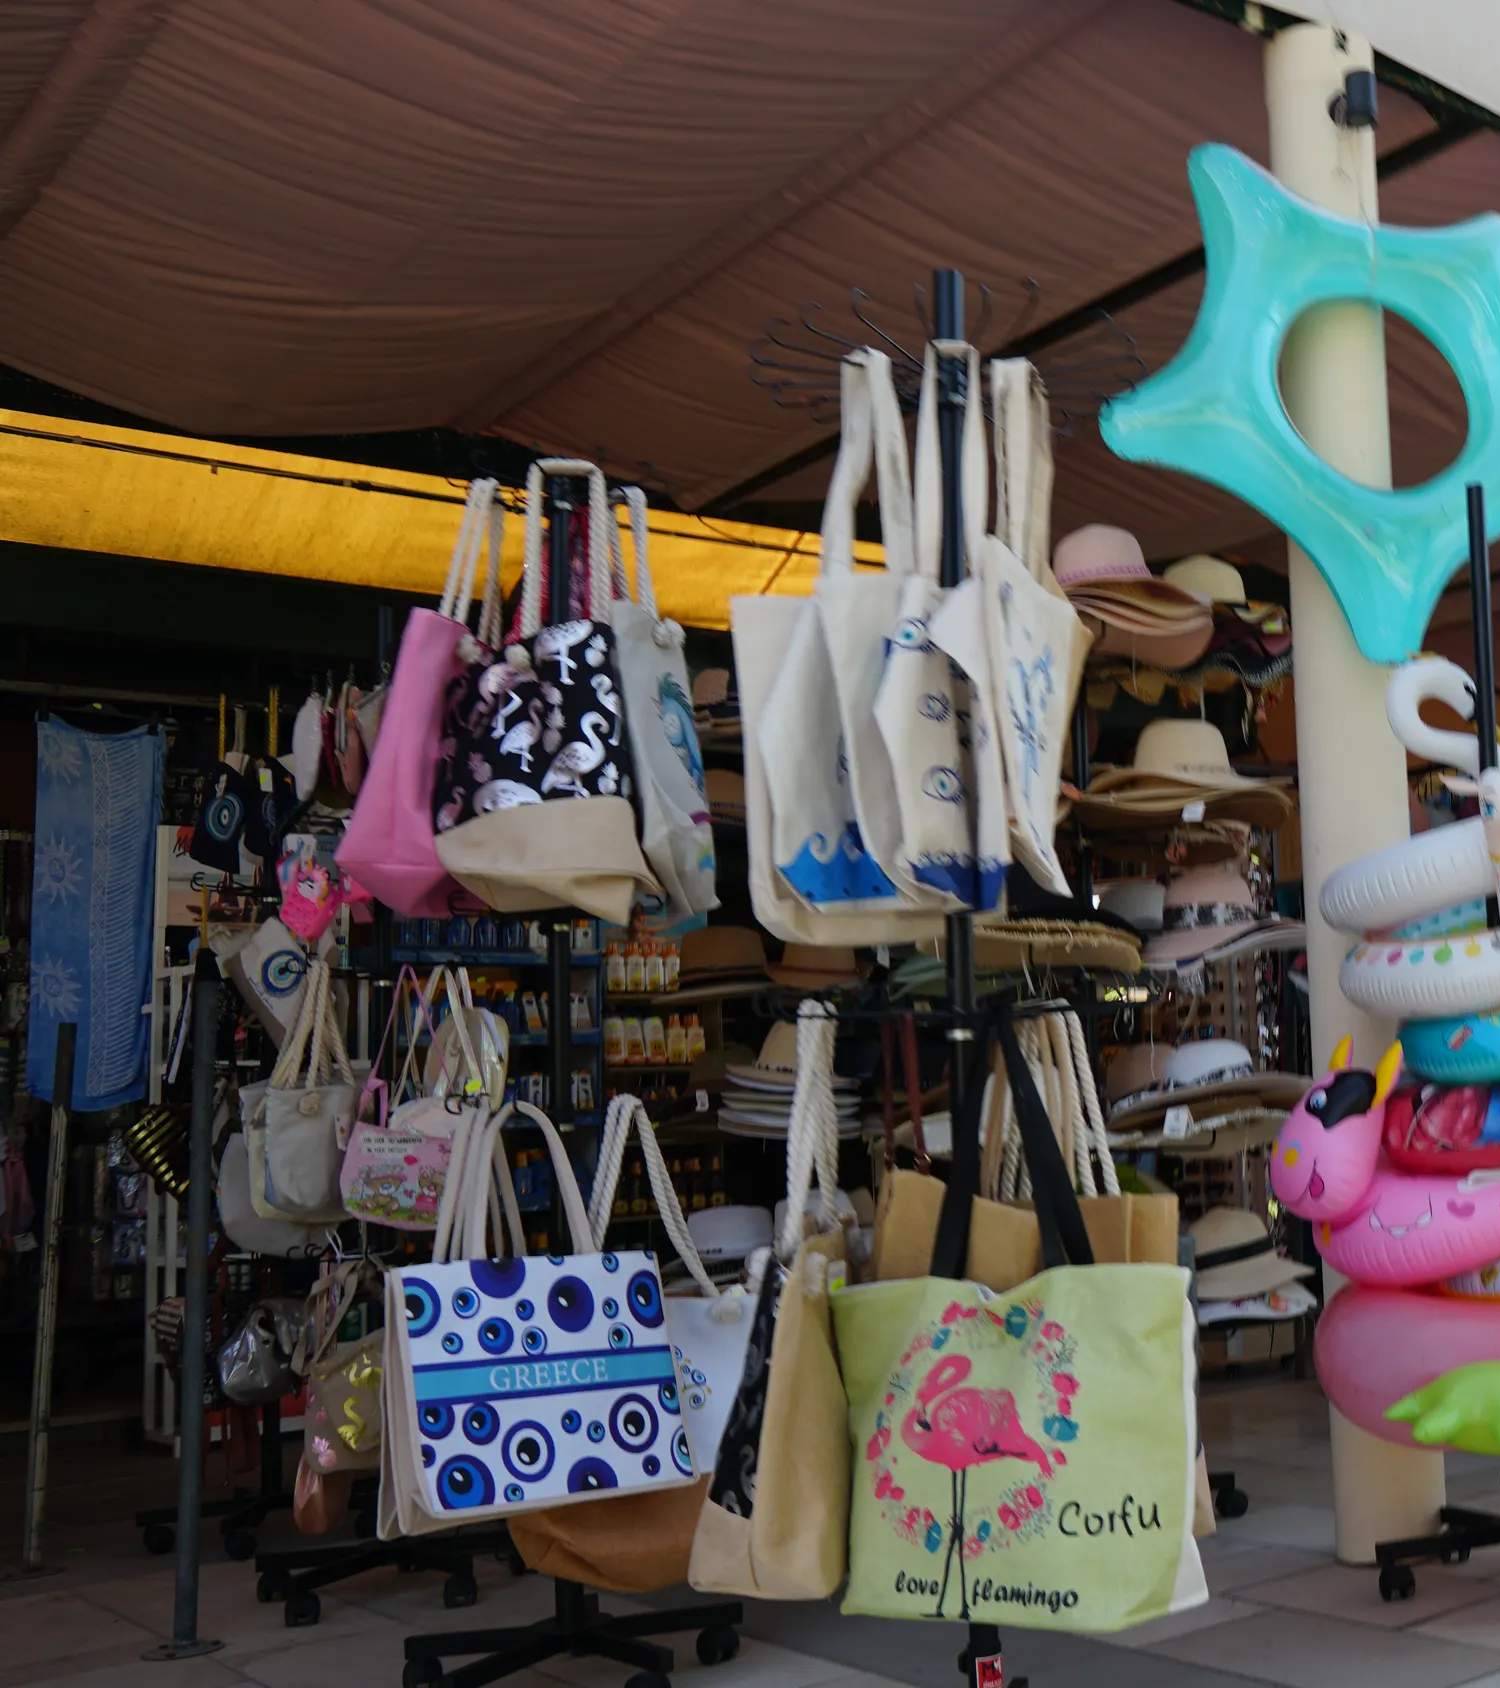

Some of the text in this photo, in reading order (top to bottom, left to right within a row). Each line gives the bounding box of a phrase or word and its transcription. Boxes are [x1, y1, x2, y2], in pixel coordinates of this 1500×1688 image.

[489, 1358, 608, 1391] GREECE
[1058, 1494, 1161, 1537] Corfu
[895, 1570, 1079, 1614] love flamingo
